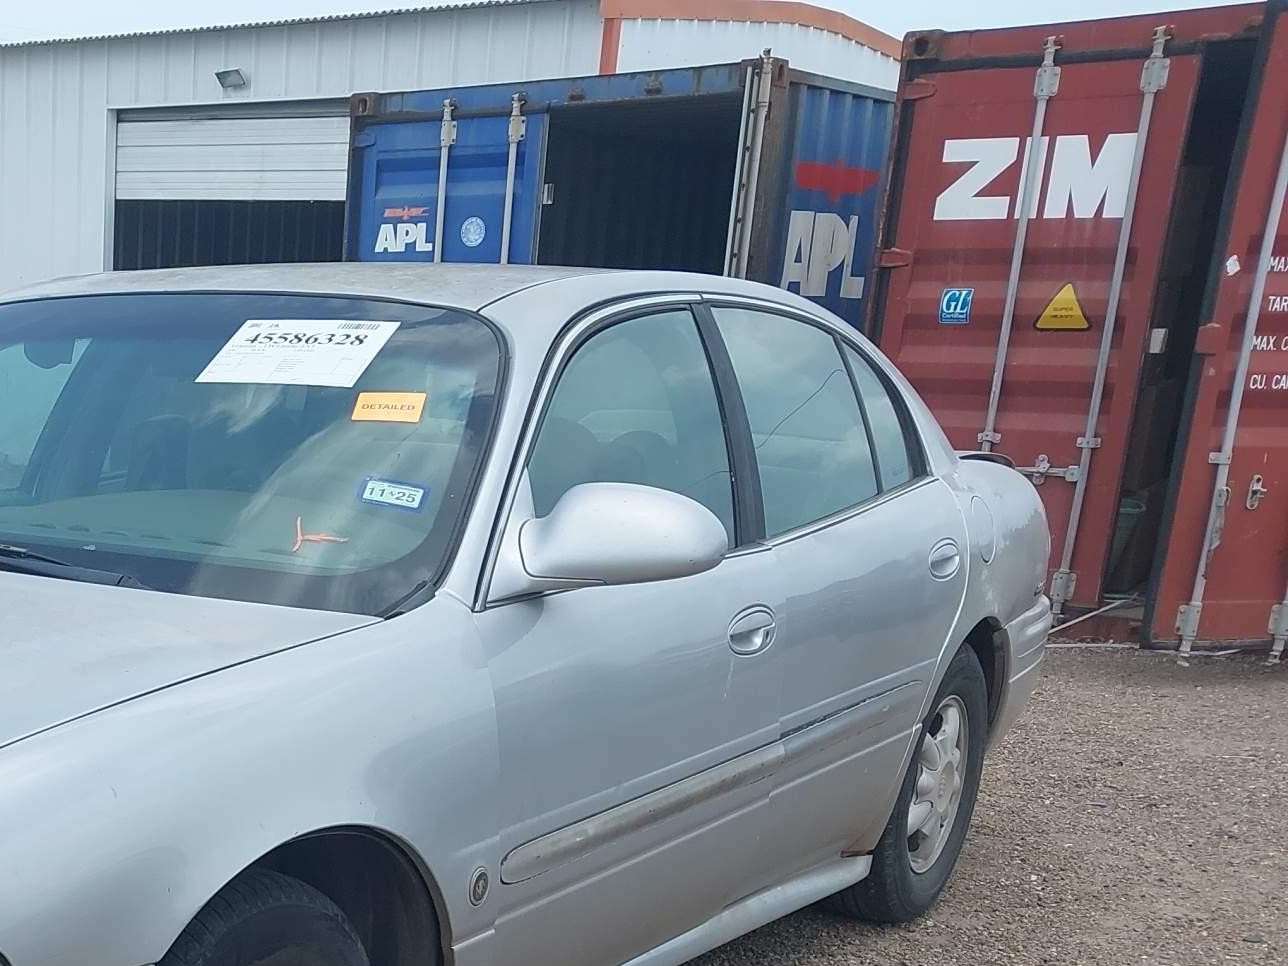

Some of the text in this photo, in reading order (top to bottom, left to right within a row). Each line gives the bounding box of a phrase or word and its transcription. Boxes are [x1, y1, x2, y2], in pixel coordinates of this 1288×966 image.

[933, 133, 1139, 221] ZIM
[374, 222, 433, 253] APL
[779, 210, 865, 299] APL
[943, 290, 969, 313] GL
[245, 332, 369, 346] 45586328
[1251, 335, 1277, 351] MAX.
[1250, 374, 1267, 389] CU.
[361, 403, 416, 411] DETAILED
